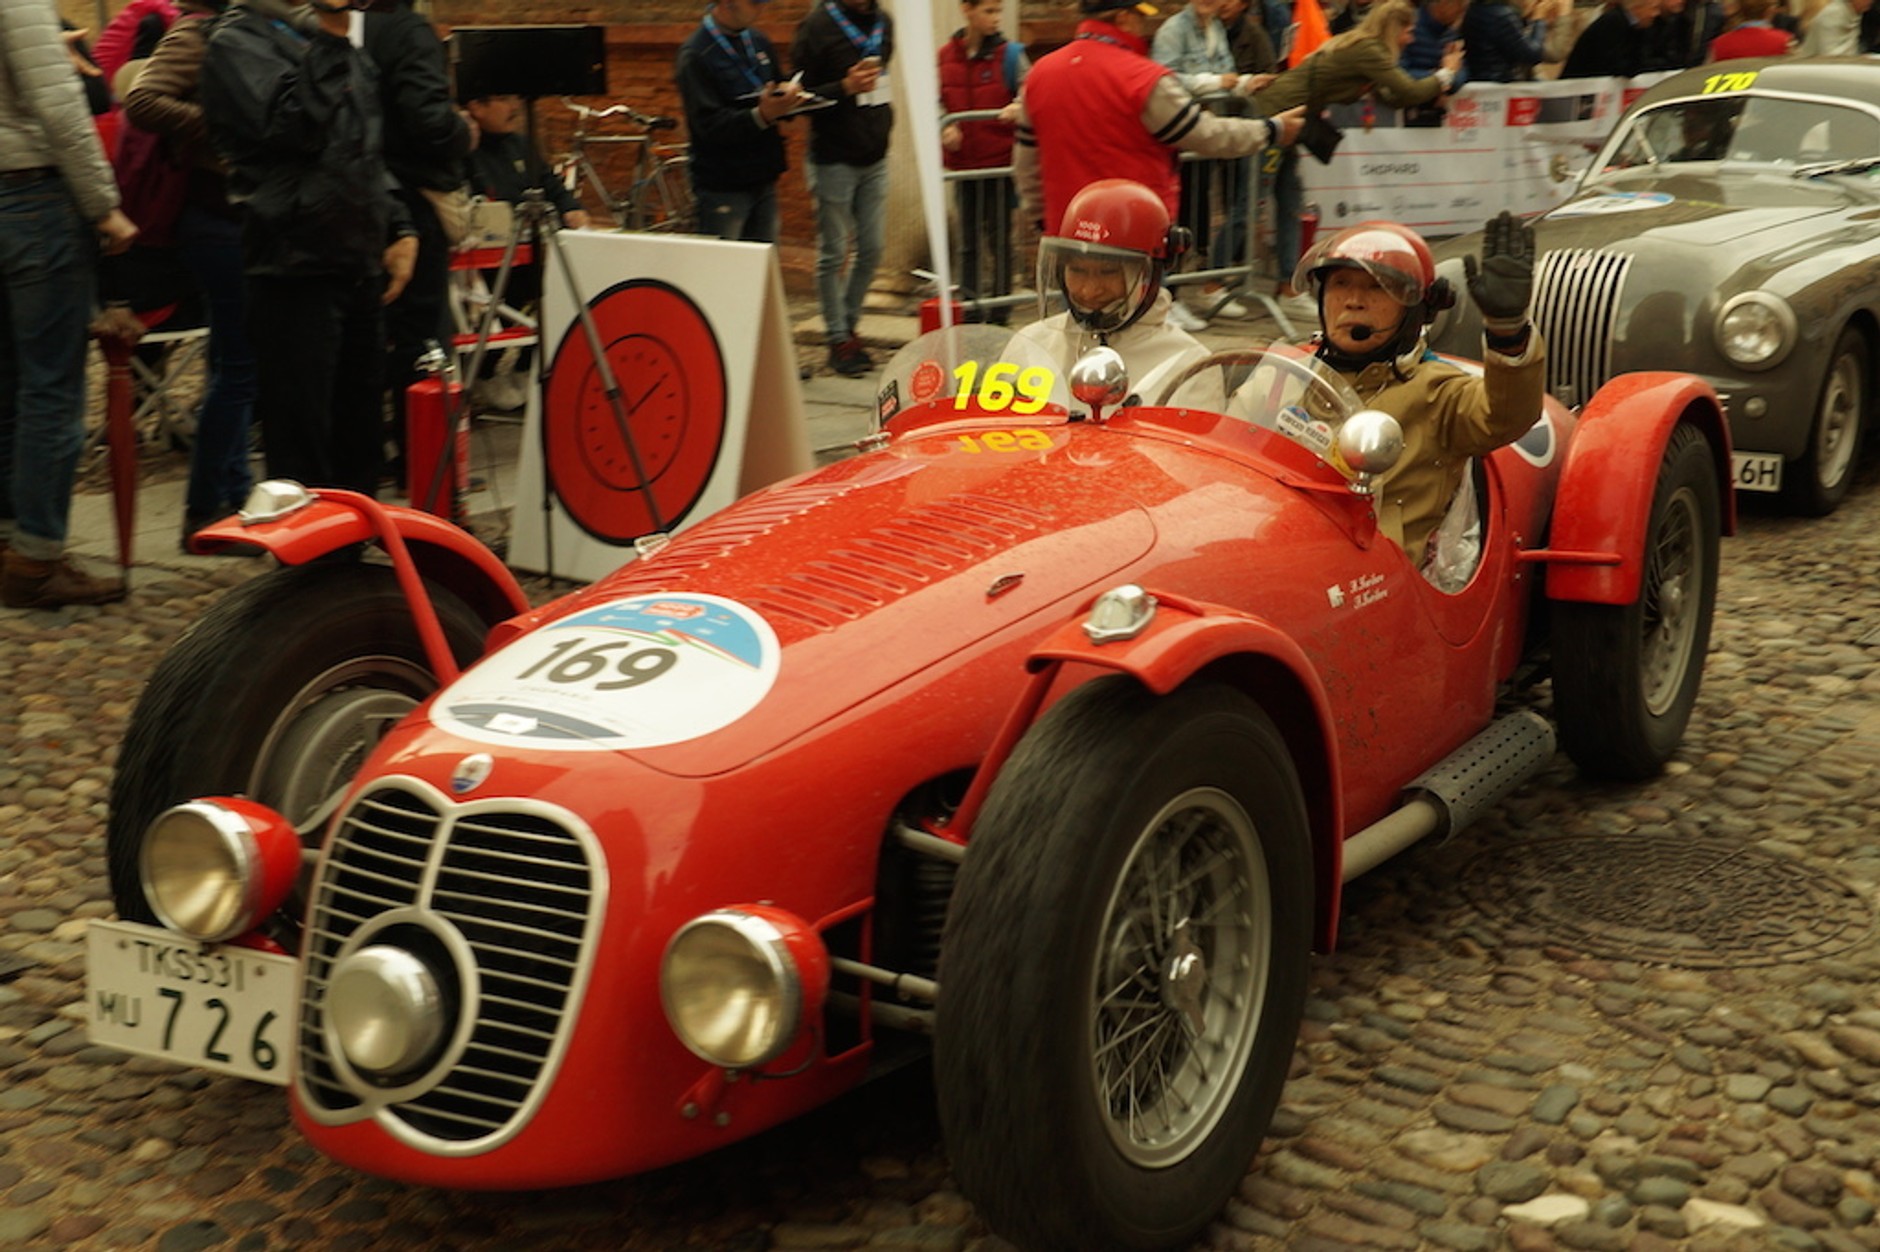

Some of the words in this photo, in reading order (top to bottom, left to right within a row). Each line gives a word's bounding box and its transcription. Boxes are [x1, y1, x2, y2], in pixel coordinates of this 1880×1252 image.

[1702, 71, 1758, 94] 170
[952, 360, 1055, 414] 169
[1732, 459, 1778, 487] 6H
[516, 637, 678, 691] 169
[158, 987, 278, 1071] 726
